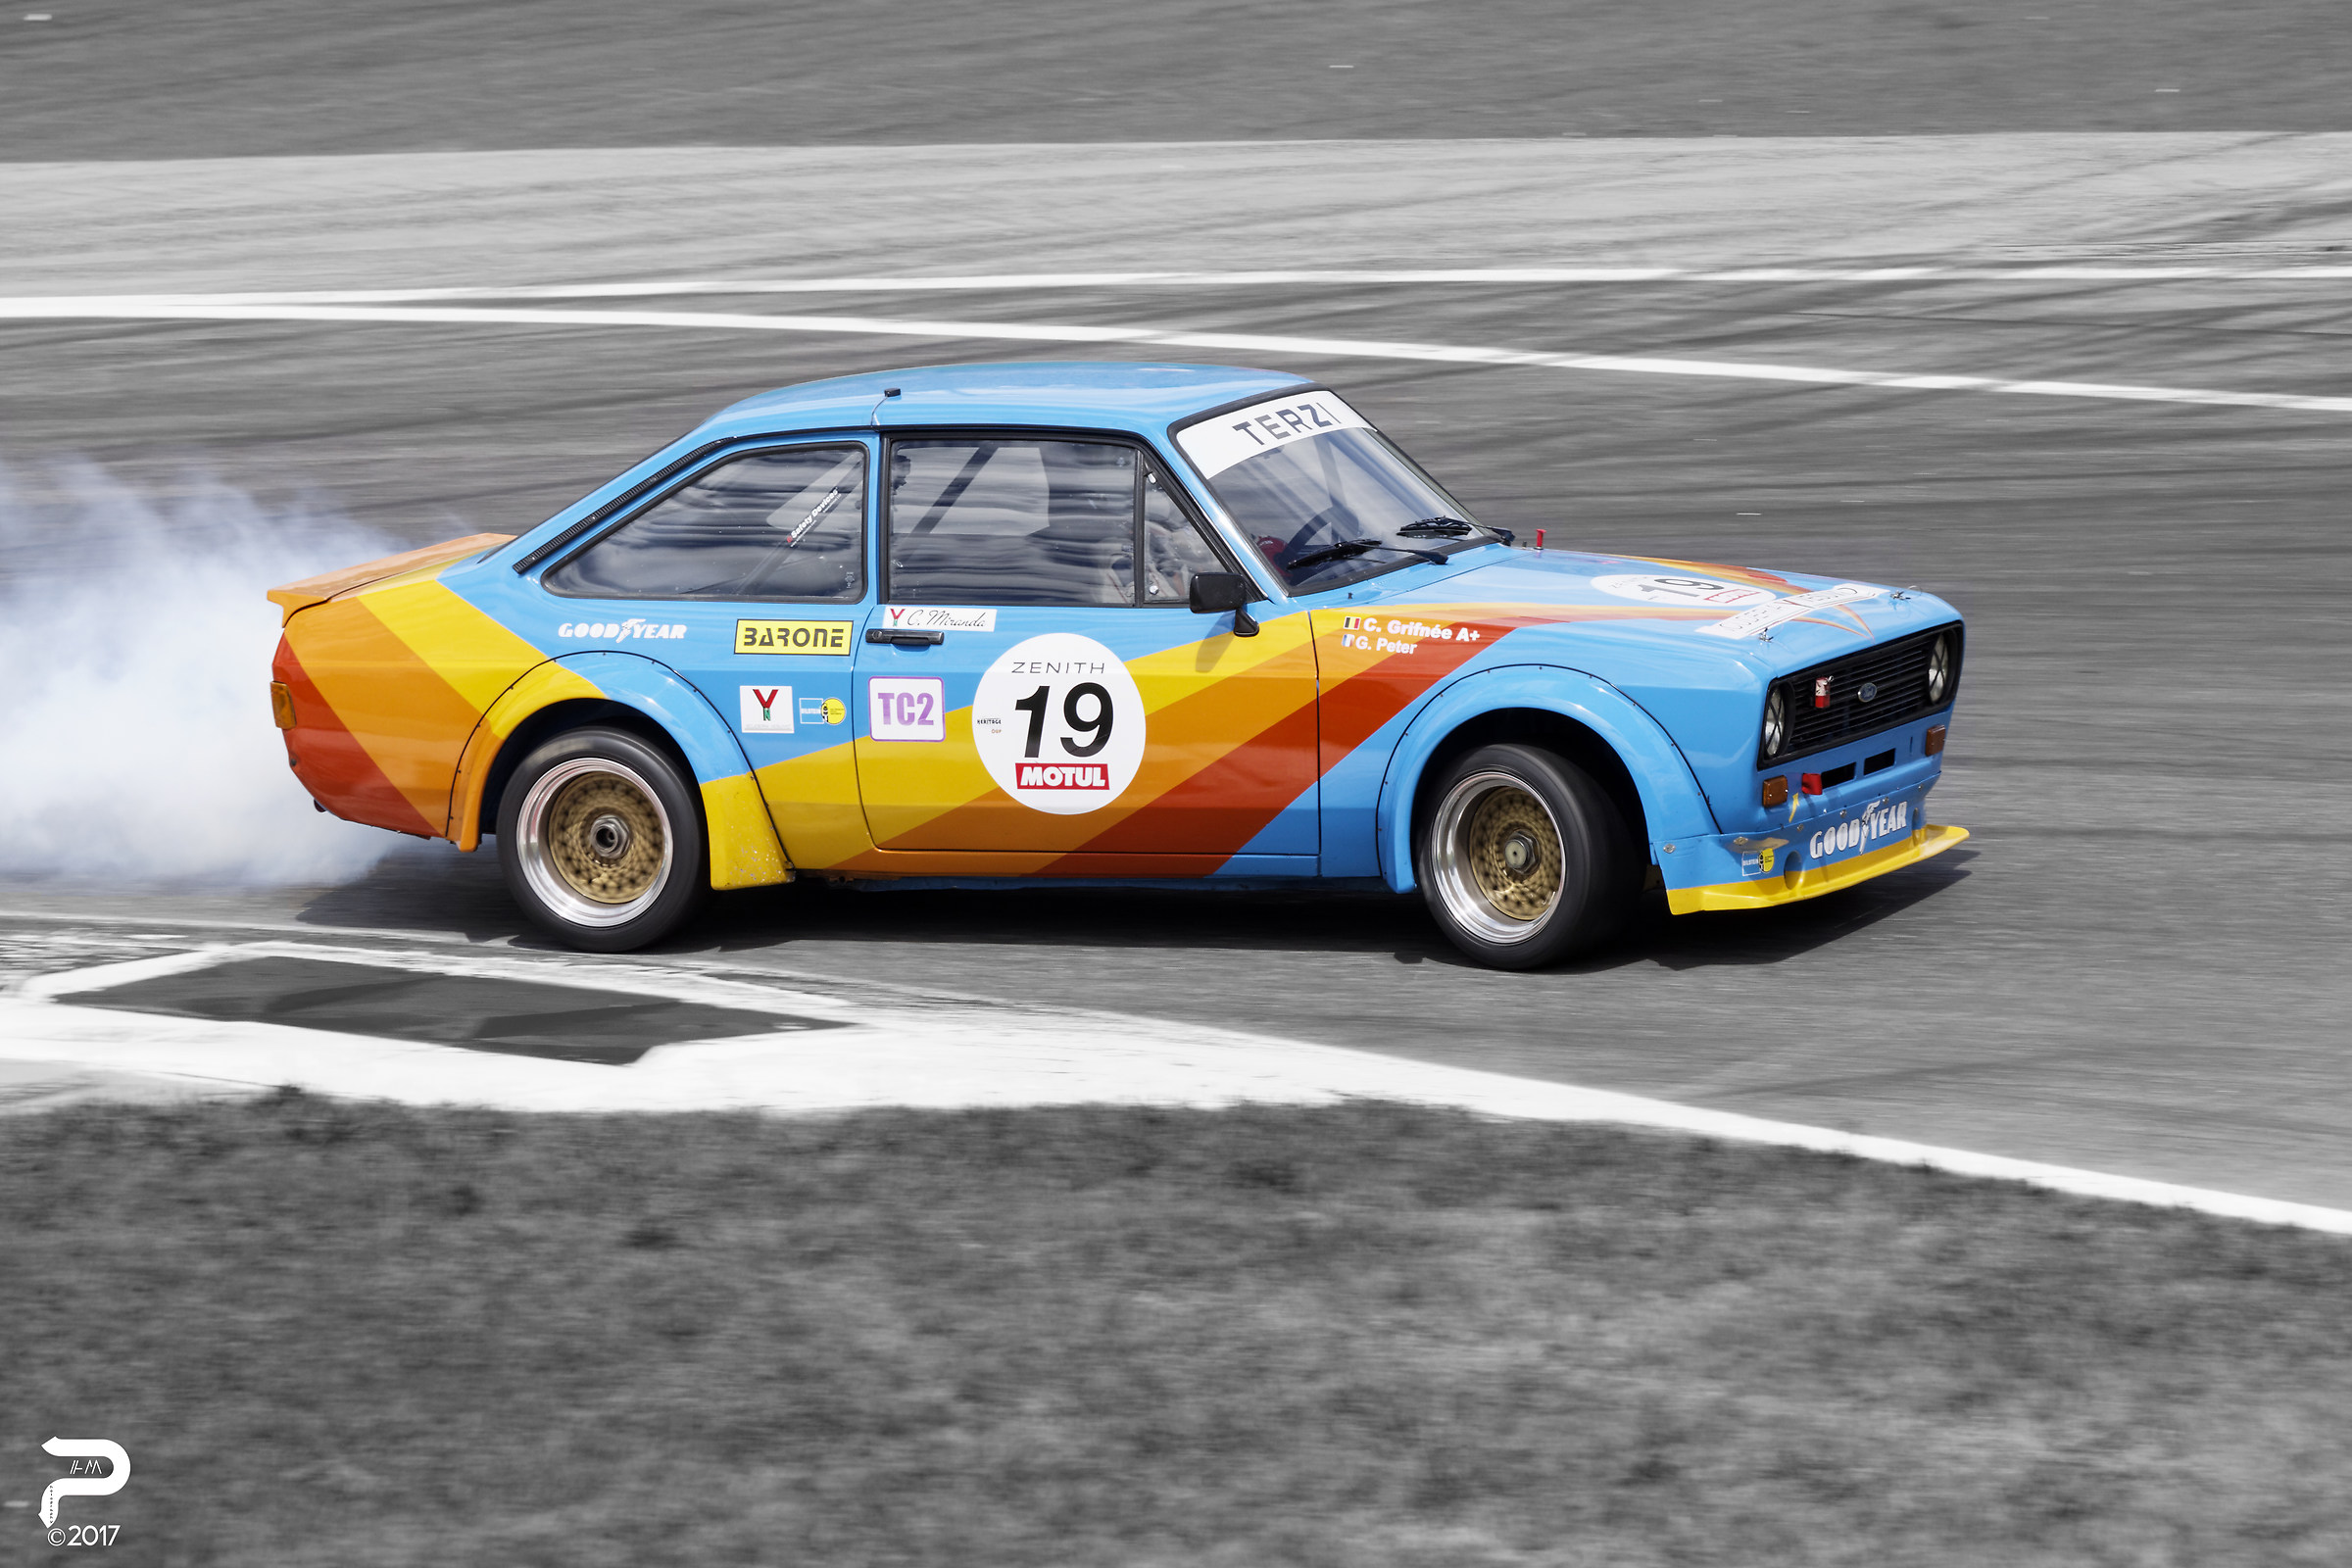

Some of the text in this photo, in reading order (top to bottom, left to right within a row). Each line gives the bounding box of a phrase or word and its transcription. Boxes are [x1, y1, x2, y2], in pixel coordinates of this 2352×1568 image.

[1232, 402, 1342, 445] TERZI
[791, 515, 812, 538] Safety
[1638, 578, 1724, 597] 19
[907, 610, 986, 627] C. Miranda
[744, 627, 844, 647] BARONE
[1363, 617, 1481, 642] C. Grifnée A+
[1355, 636, 1418, 655] G. Peter
[1011, 662, 1105, 674] ZENITH
[877, 692, 934, 725] TC2
[1015, 682, 1113, 759] 19
[1020, 766, 1105, 787] MOTUL
